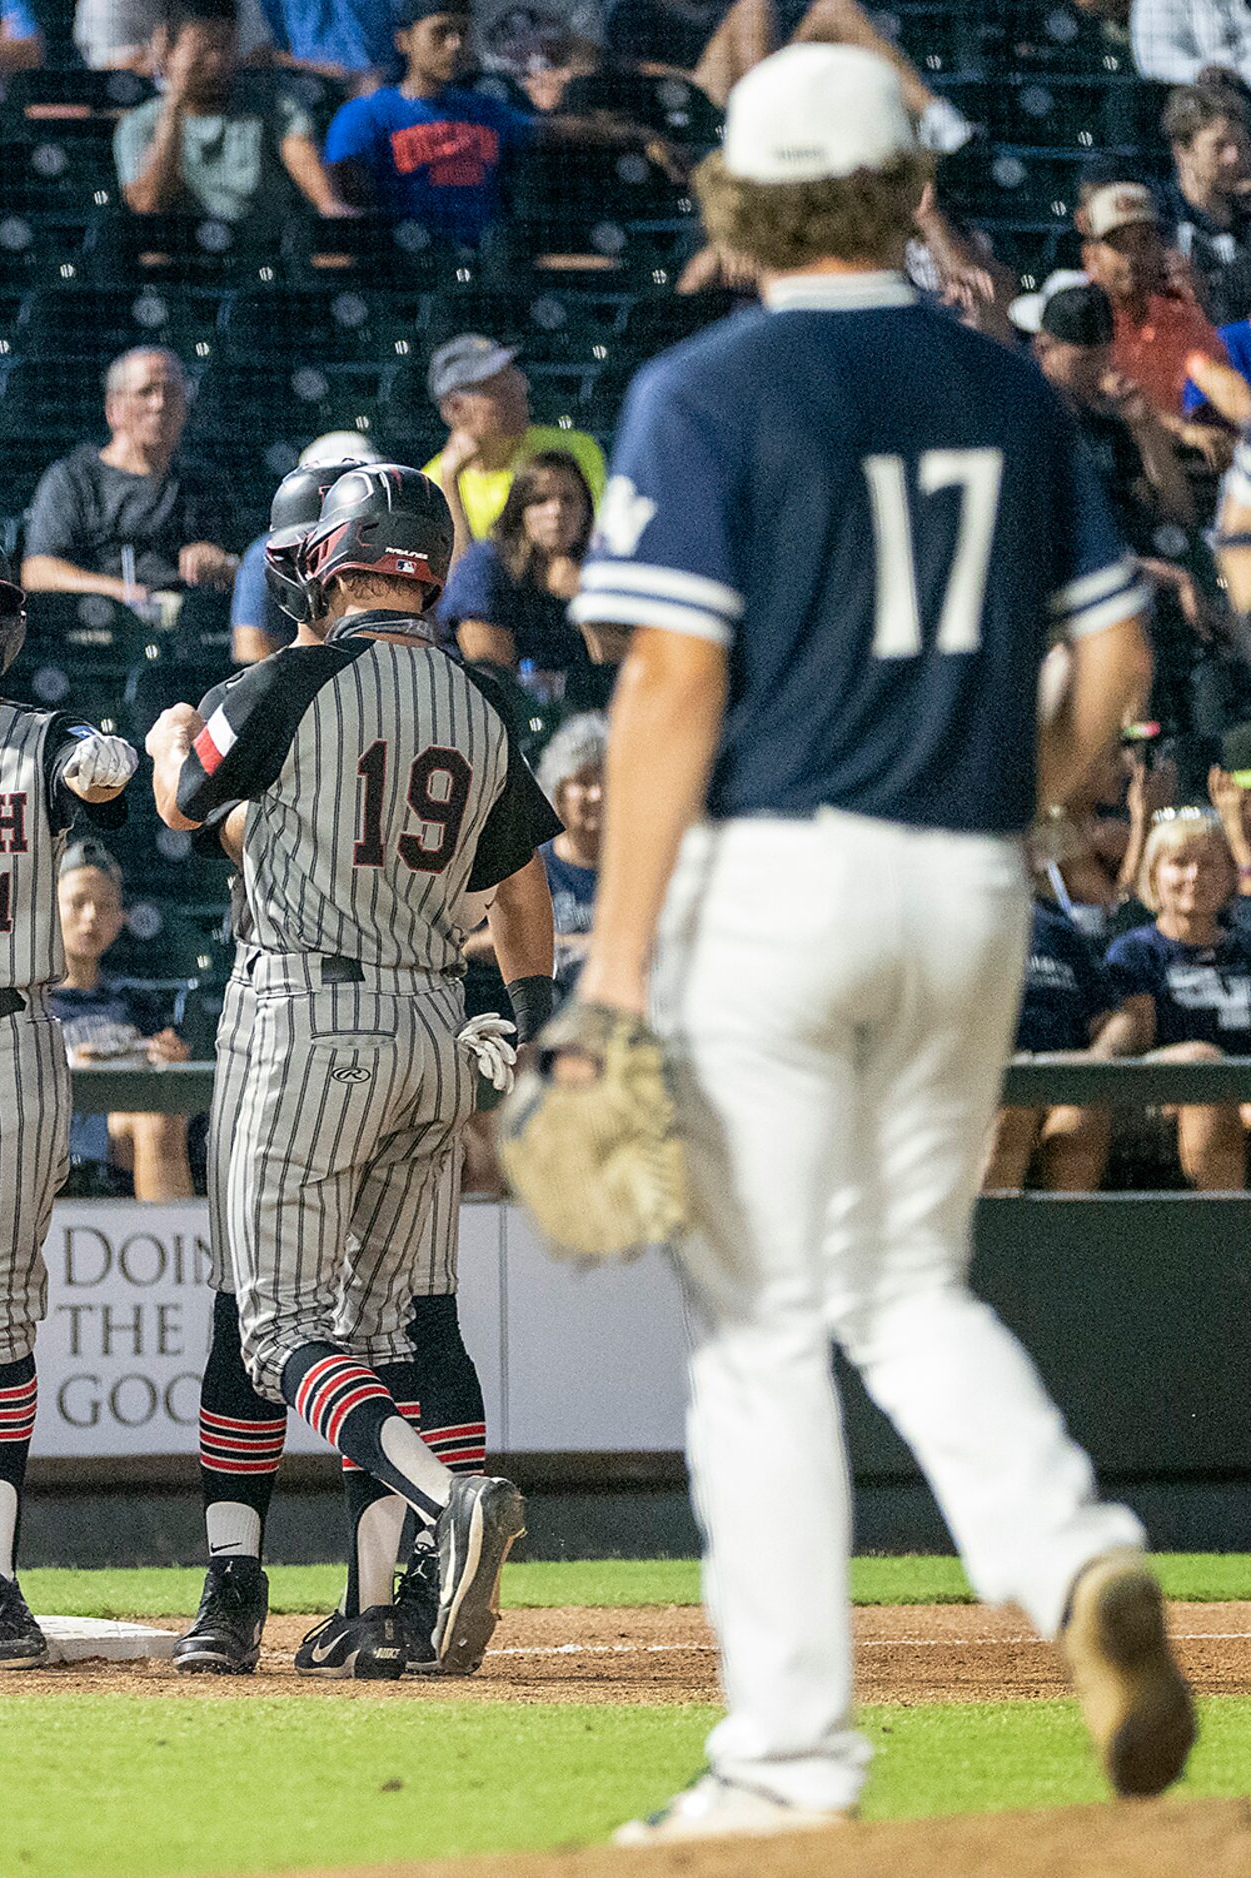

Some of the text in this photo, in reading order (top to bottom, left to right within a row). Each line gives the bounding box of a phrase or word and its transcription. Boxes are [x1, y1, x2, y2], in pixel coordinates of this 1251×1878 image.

[861, 447, 1004, 659] 17
[352, 739, 474, 875] 19
[64, 1226, 214, 1287] DOIN
[56, 1303, 185, 1357] THE
[57, 1371, 203, 1428] GOO
